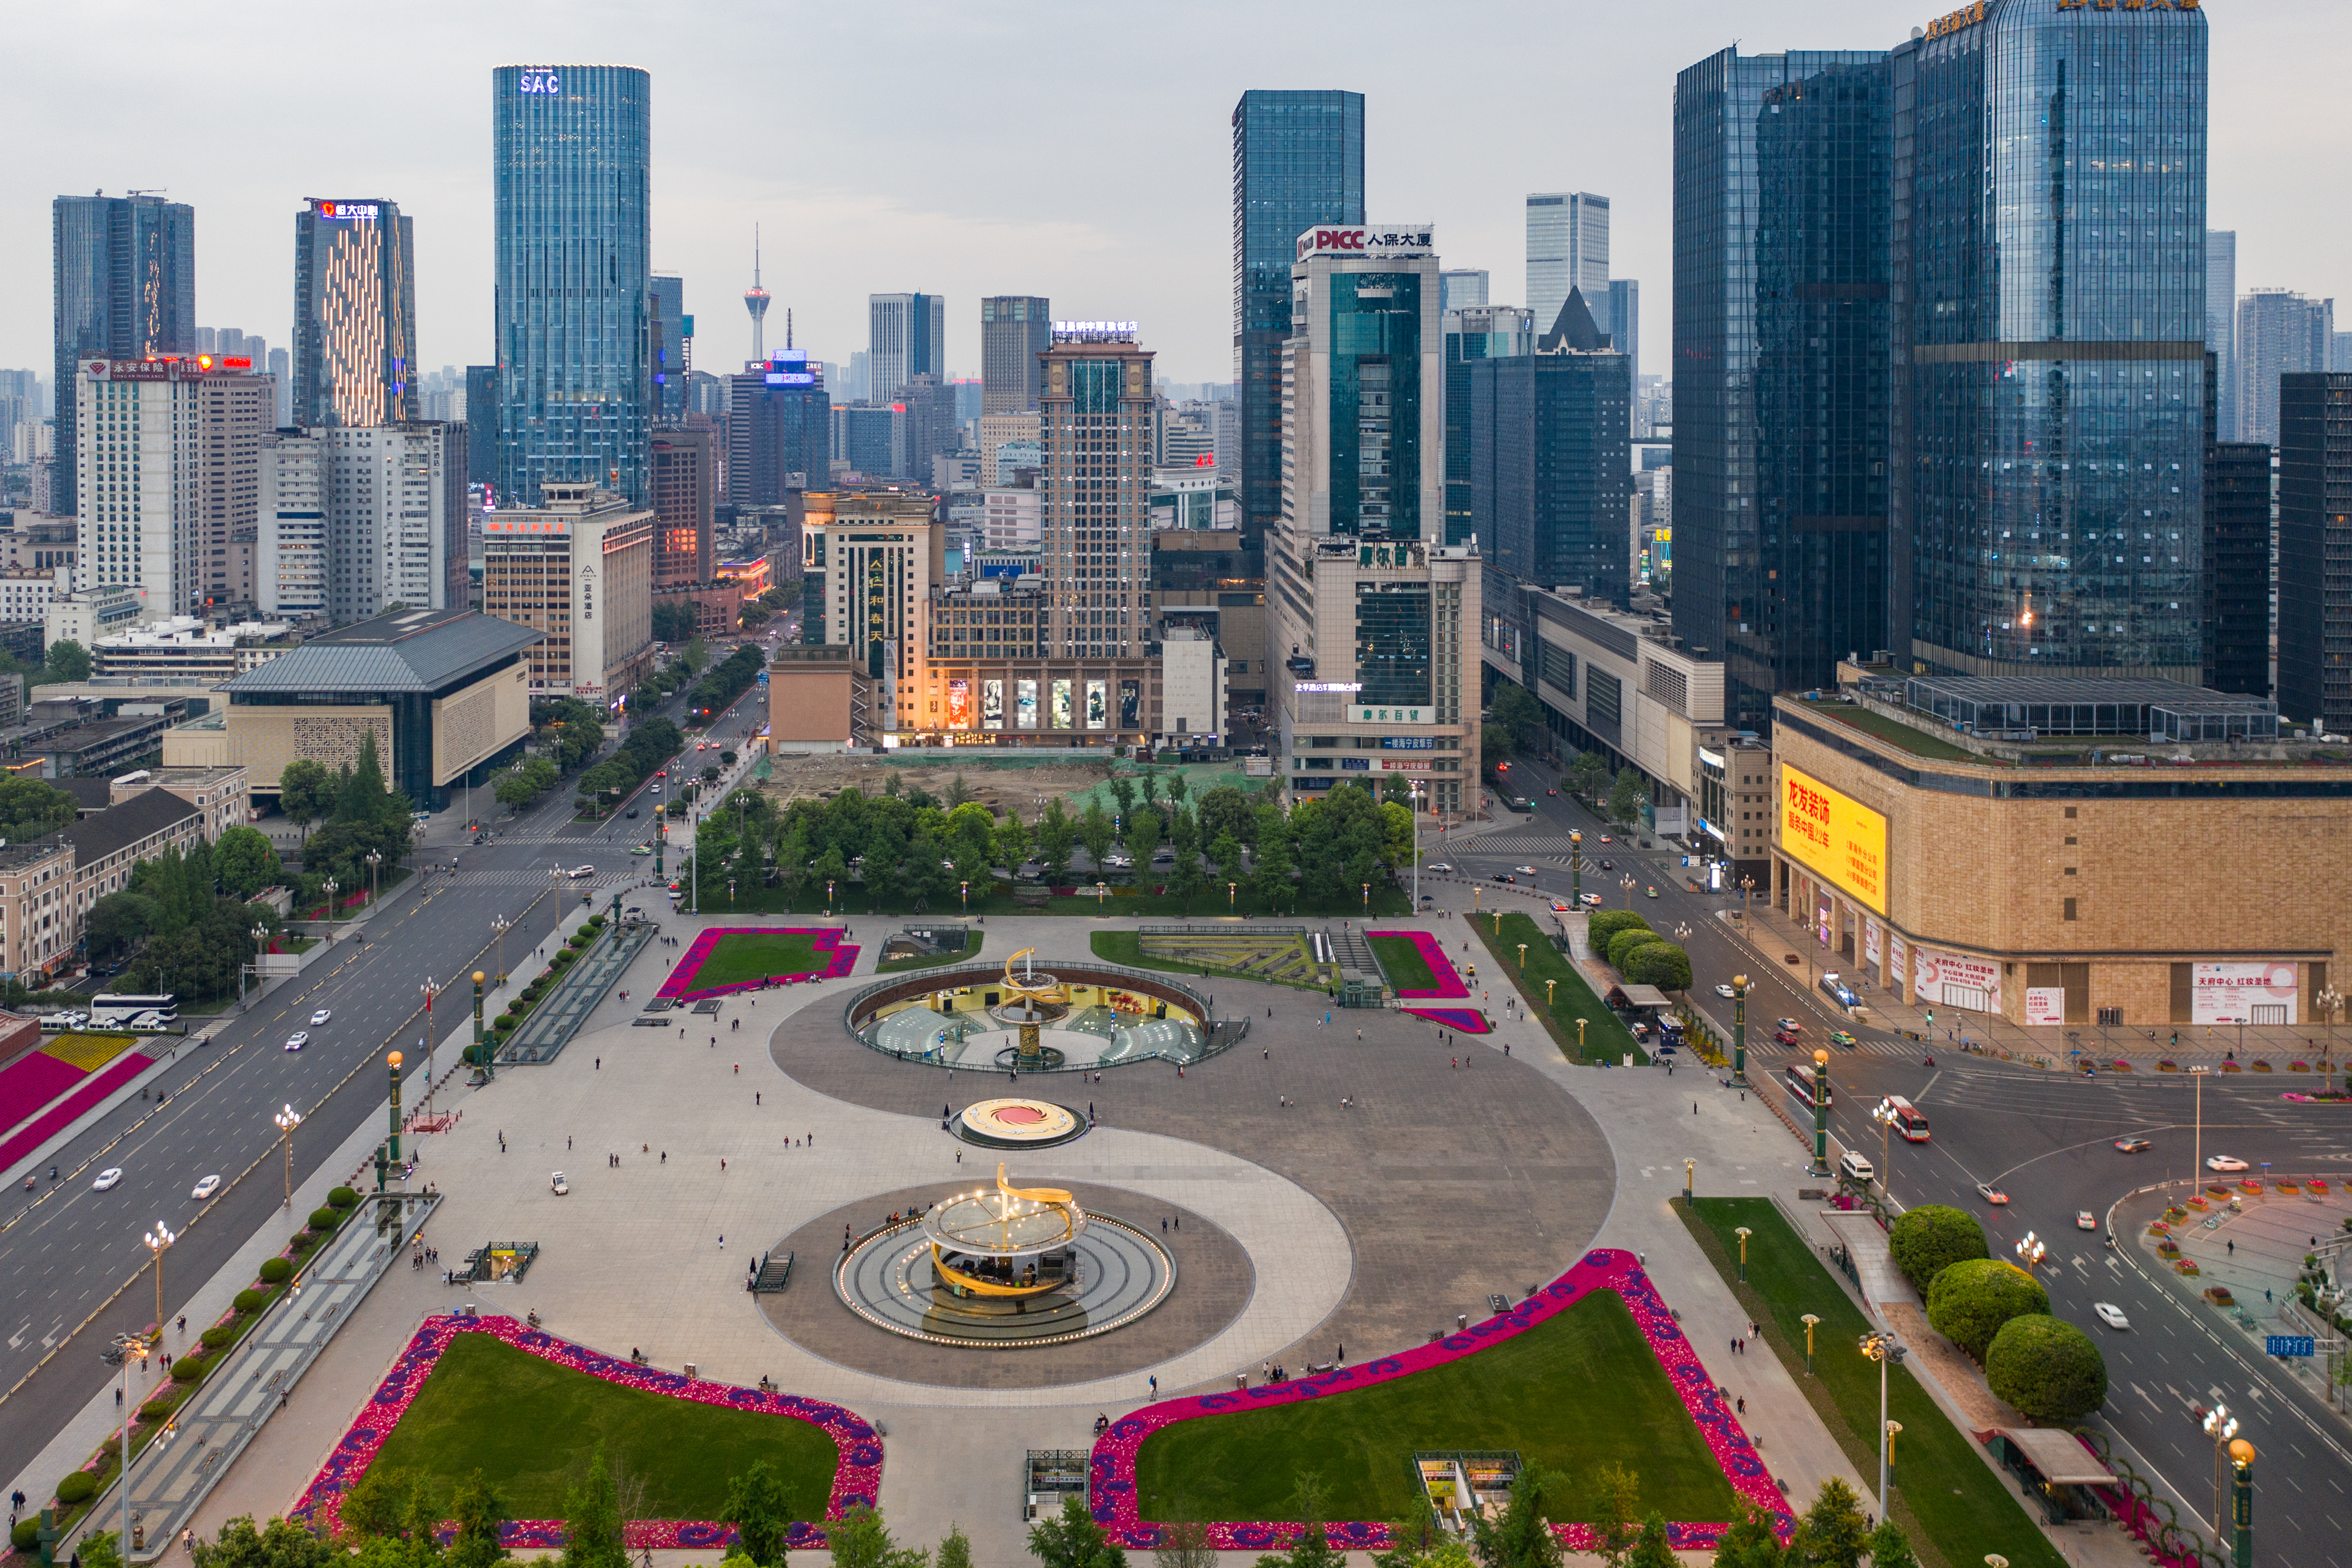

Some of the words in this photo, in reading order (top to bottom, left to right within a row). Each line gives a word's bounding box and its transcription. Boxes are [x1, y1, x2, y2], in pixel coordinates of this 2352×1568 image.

[520, 75, 559, 93] SAC
[336, 205, 378, 215] 恒大中心
[1317, 230, 1364, 249] PICC
[1368, 233, 1432, 246] 人保大厦
[113, 362, 164, 372] 永安保险
[584, 584, 592, 619] 亚朵酒店
[869, 577, 884, 641] 仁和春天
[1363, 709, 1413, 721] 摩尔百货
[1385, 738, 1433, 748] 一楼海宁皮草节
[1788, 778, 1829, 827] 龙发装饰
[1788, 810, 1829, 850] 服务中国22年
[1935, 958, 1963, 969] 天府中心
[1965, 964, 1994, 975] 红妆圣地
[2199, 977, 2233, 985] 天府中心
[2237, 977, 2271, 985] 红妆圣地
